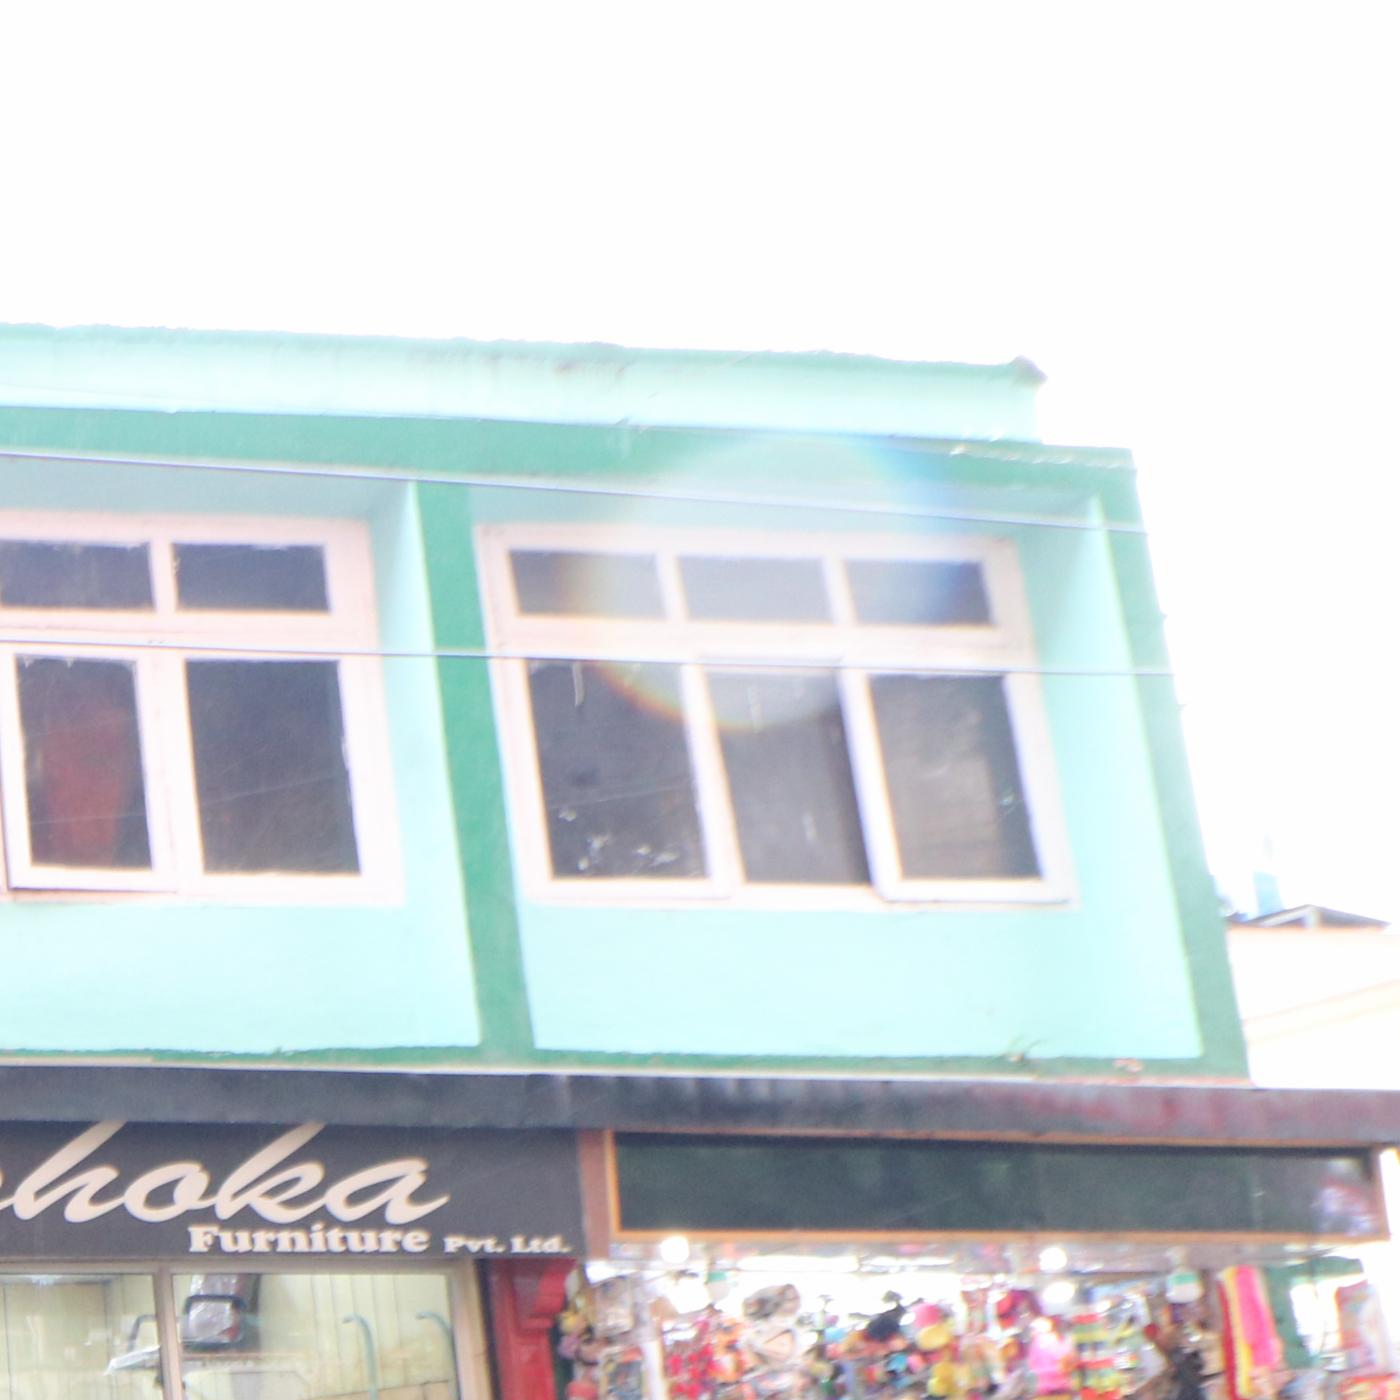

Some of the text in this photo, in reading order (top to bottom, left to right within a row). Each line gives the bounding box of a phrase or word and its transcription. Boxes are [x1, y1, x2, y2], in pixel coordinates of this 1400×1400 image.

[188, 1222, 572, 1255] Furniture Pvt. Ltd.
